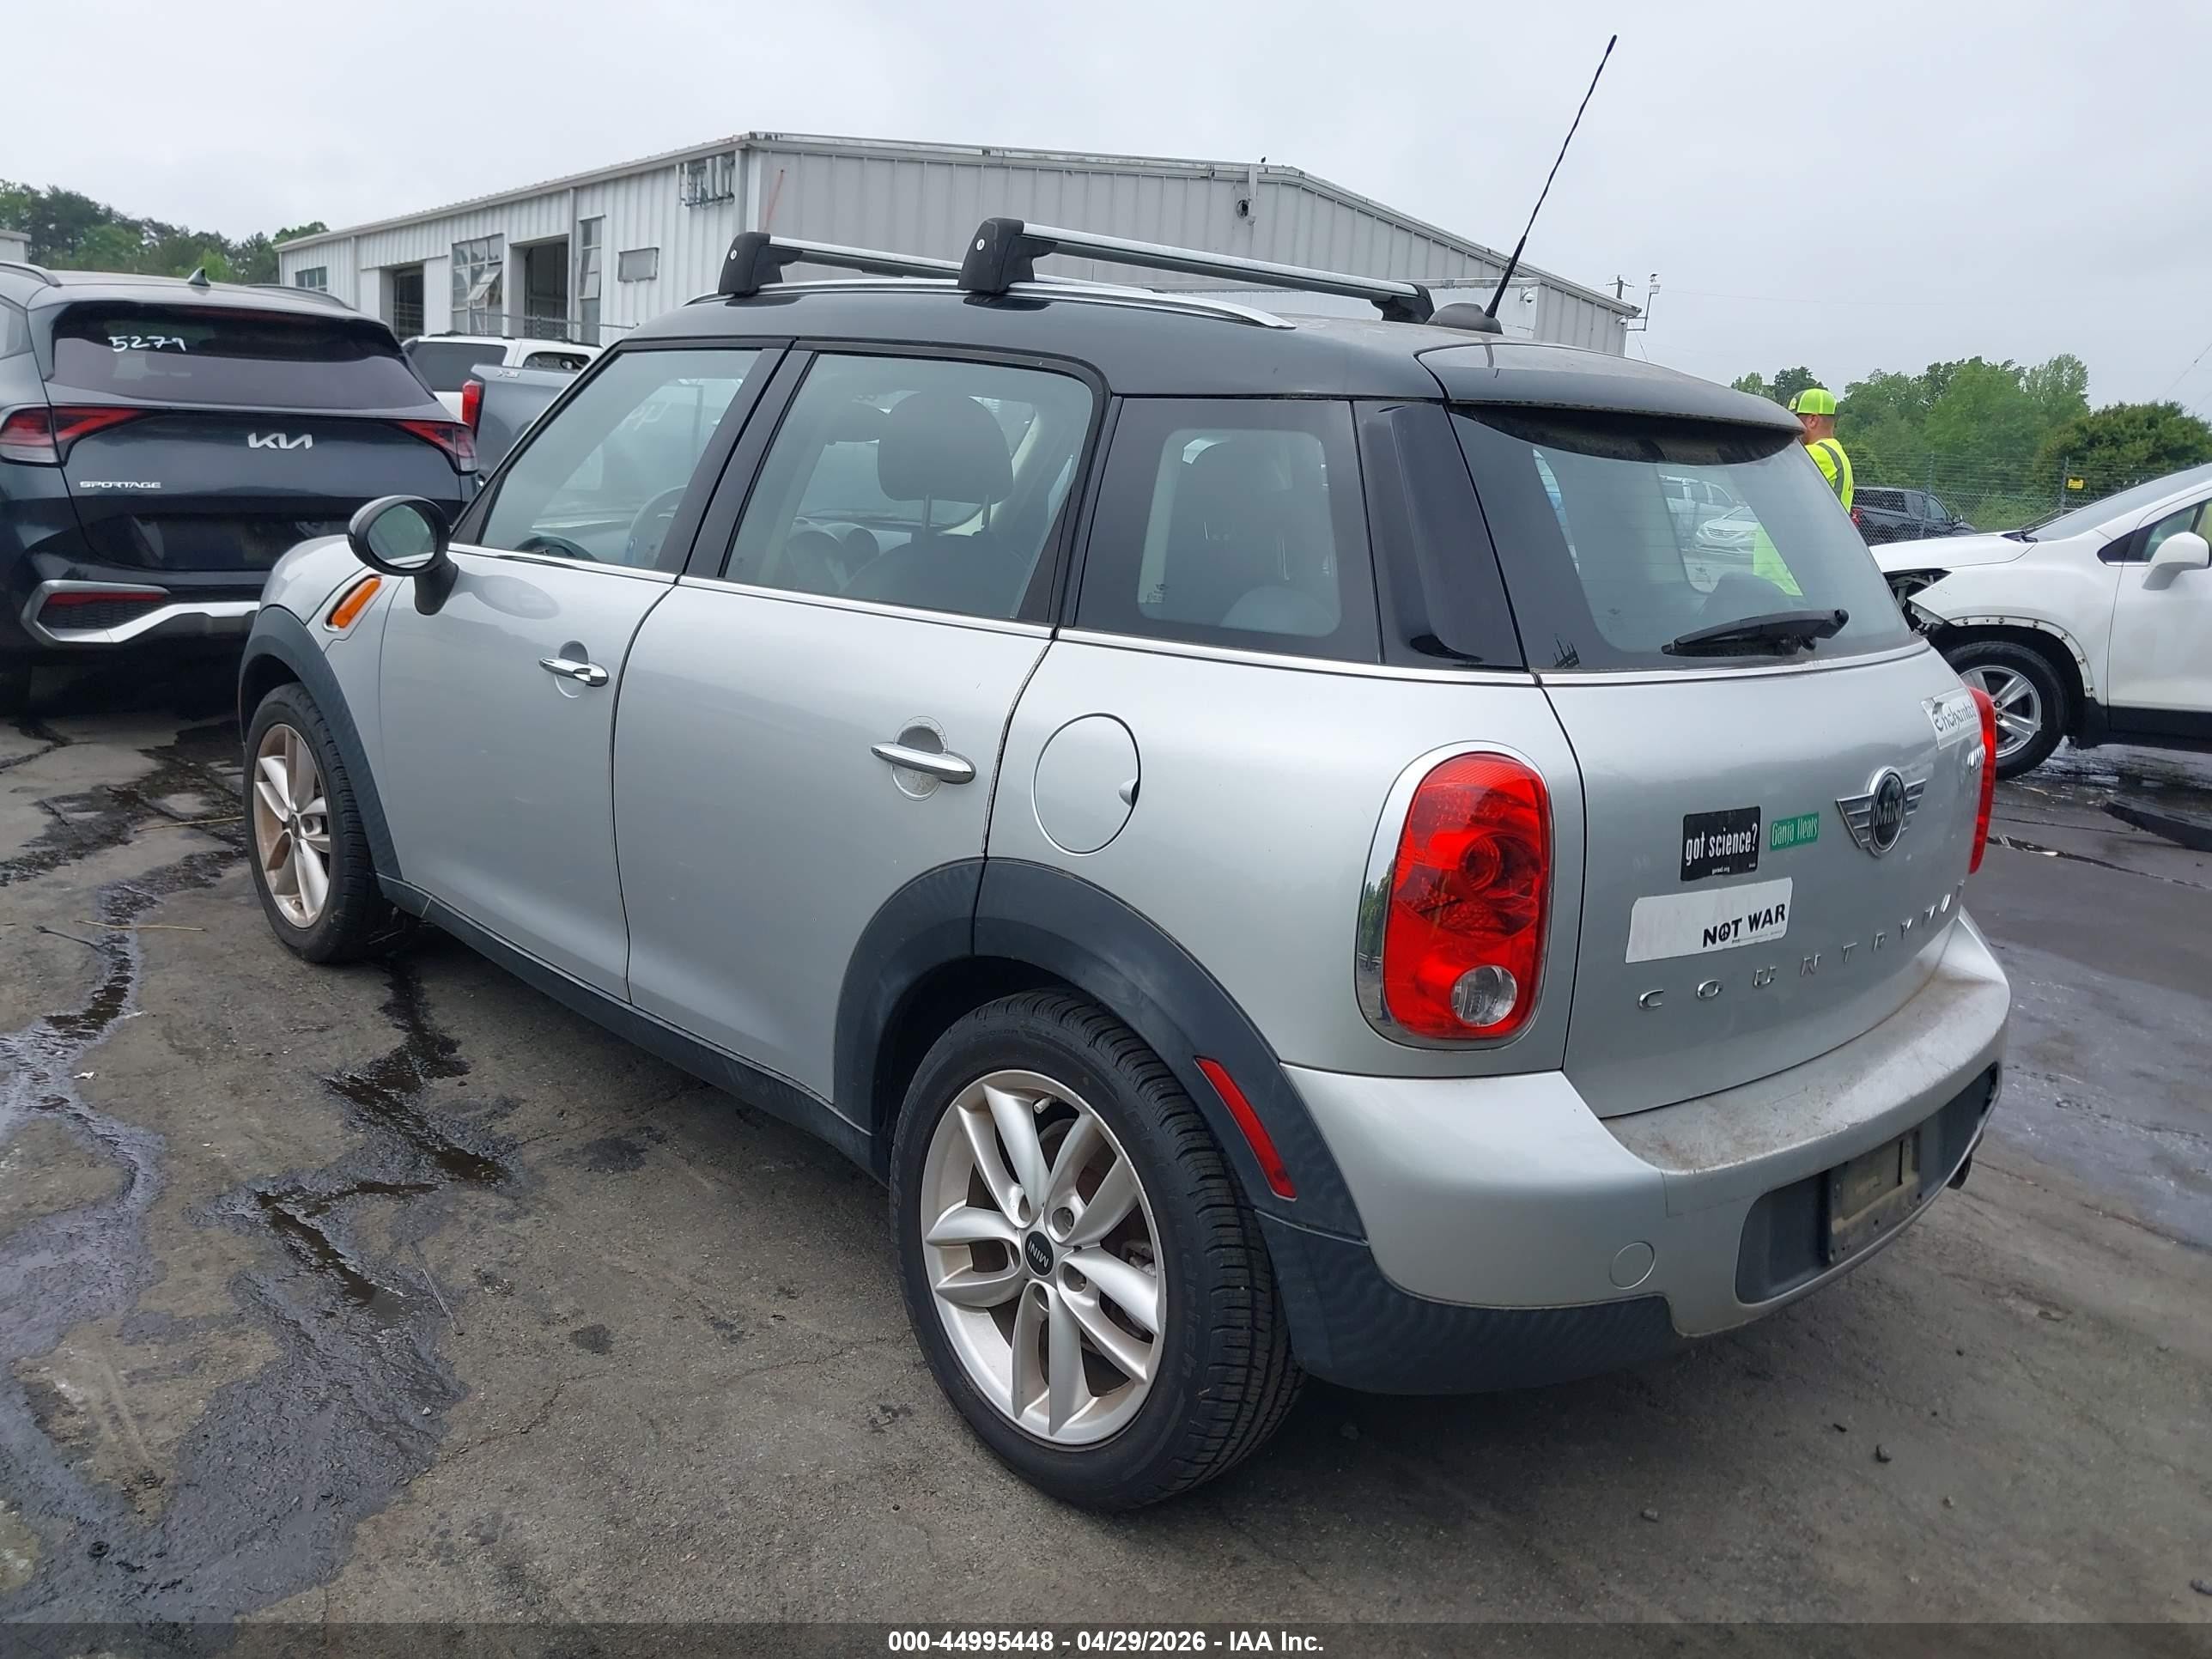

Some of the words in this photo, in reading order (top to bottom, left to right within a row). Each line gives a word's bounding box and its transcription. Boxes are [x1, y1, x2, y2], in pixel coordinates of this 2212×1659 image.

[247, 433, 313, 450] KIA
[79, 481, 161, 489] SPORTAGE
[1875, 799, 1904, 826] MINI
[1686, 831, 1705, 866] got
[1708, 823, 1759, 859] science?
[1771, 823, 1795, 847] Ganja
[1703, 918, 1743, 948] NOT
[1748, 902, 1786, 933] WAR
[1028, 1239, 1050, 1269] MINI
